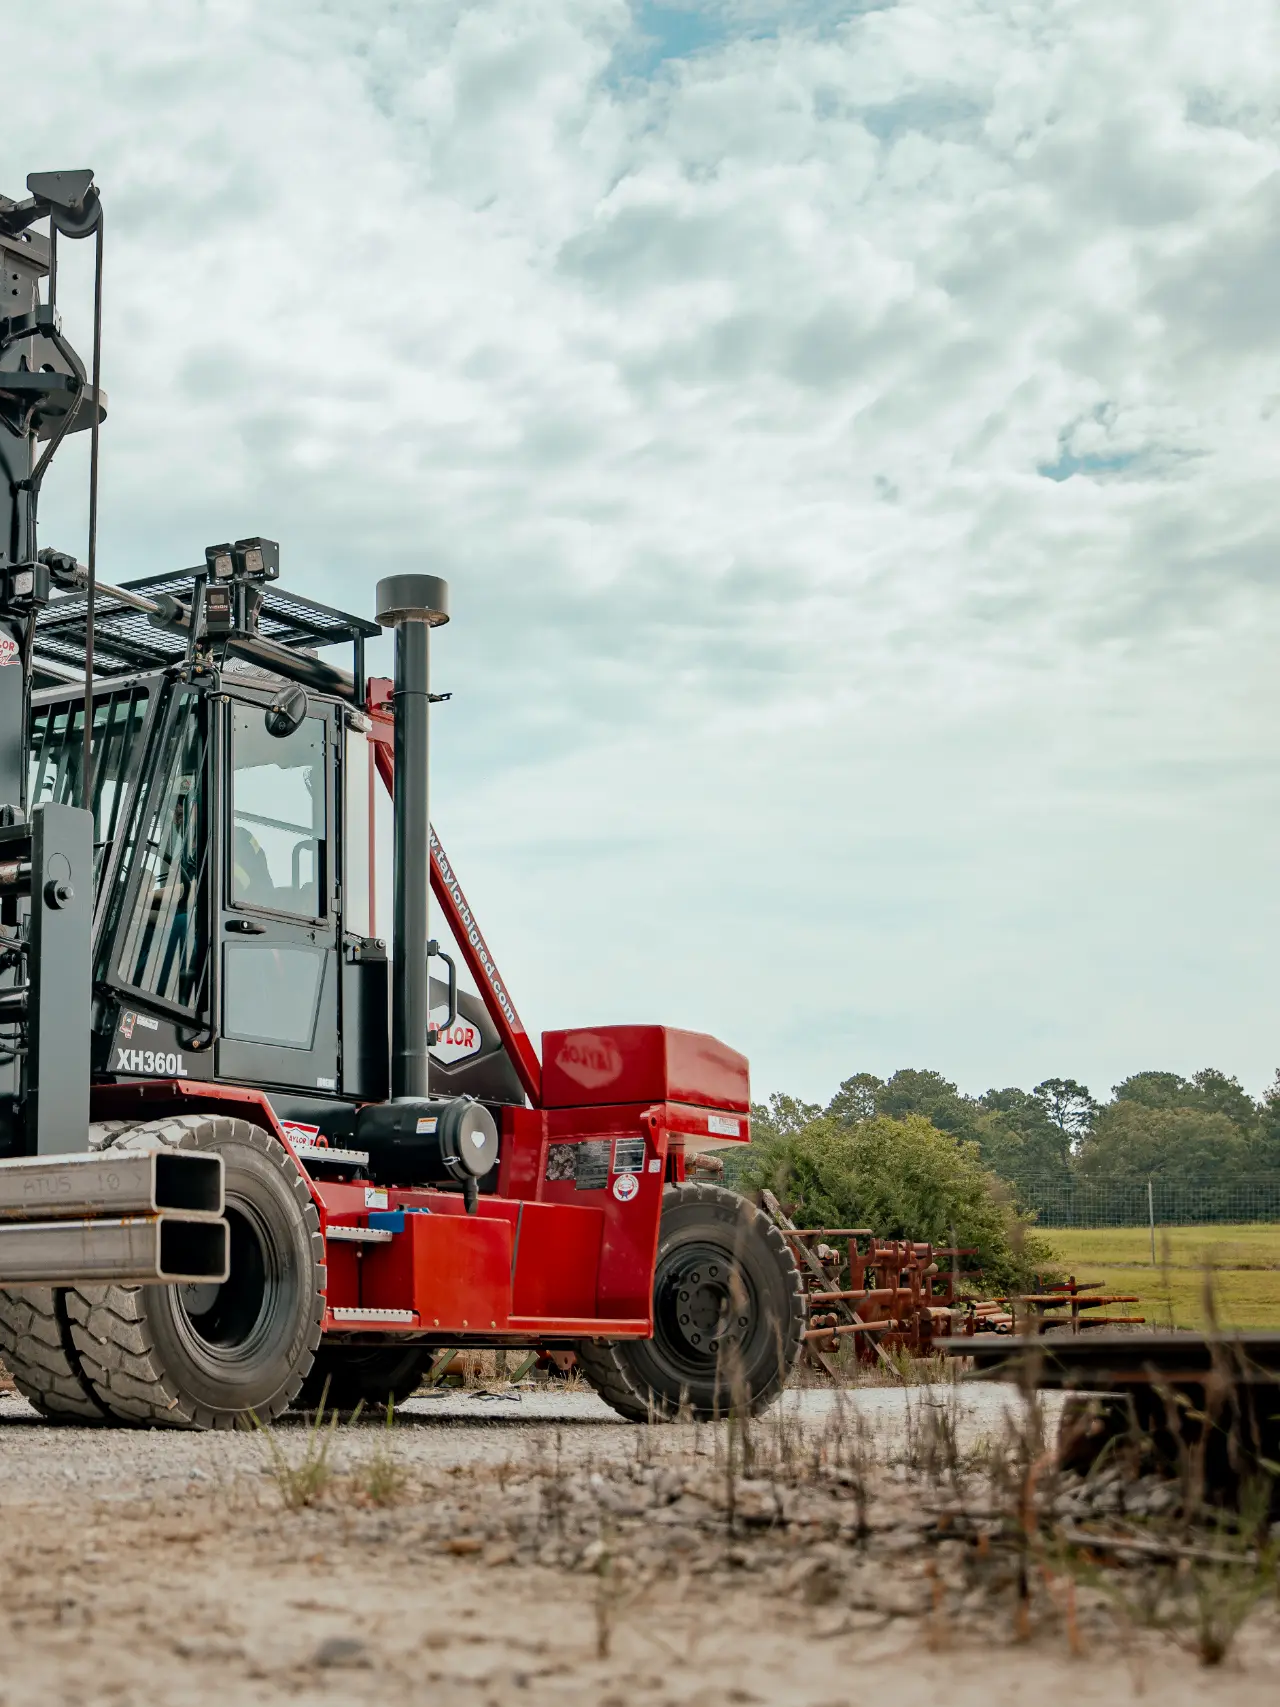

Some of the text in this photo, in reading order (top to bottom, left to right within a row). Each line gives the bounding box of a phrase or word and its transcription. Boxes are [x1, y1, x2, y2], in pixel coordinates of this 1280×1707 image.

[430, 827, 515, 1025] w.taylorbigred.com
[117, 1048, 188, 1076] XH360L
[285, 1131, 307, 1144] TAYLOR
